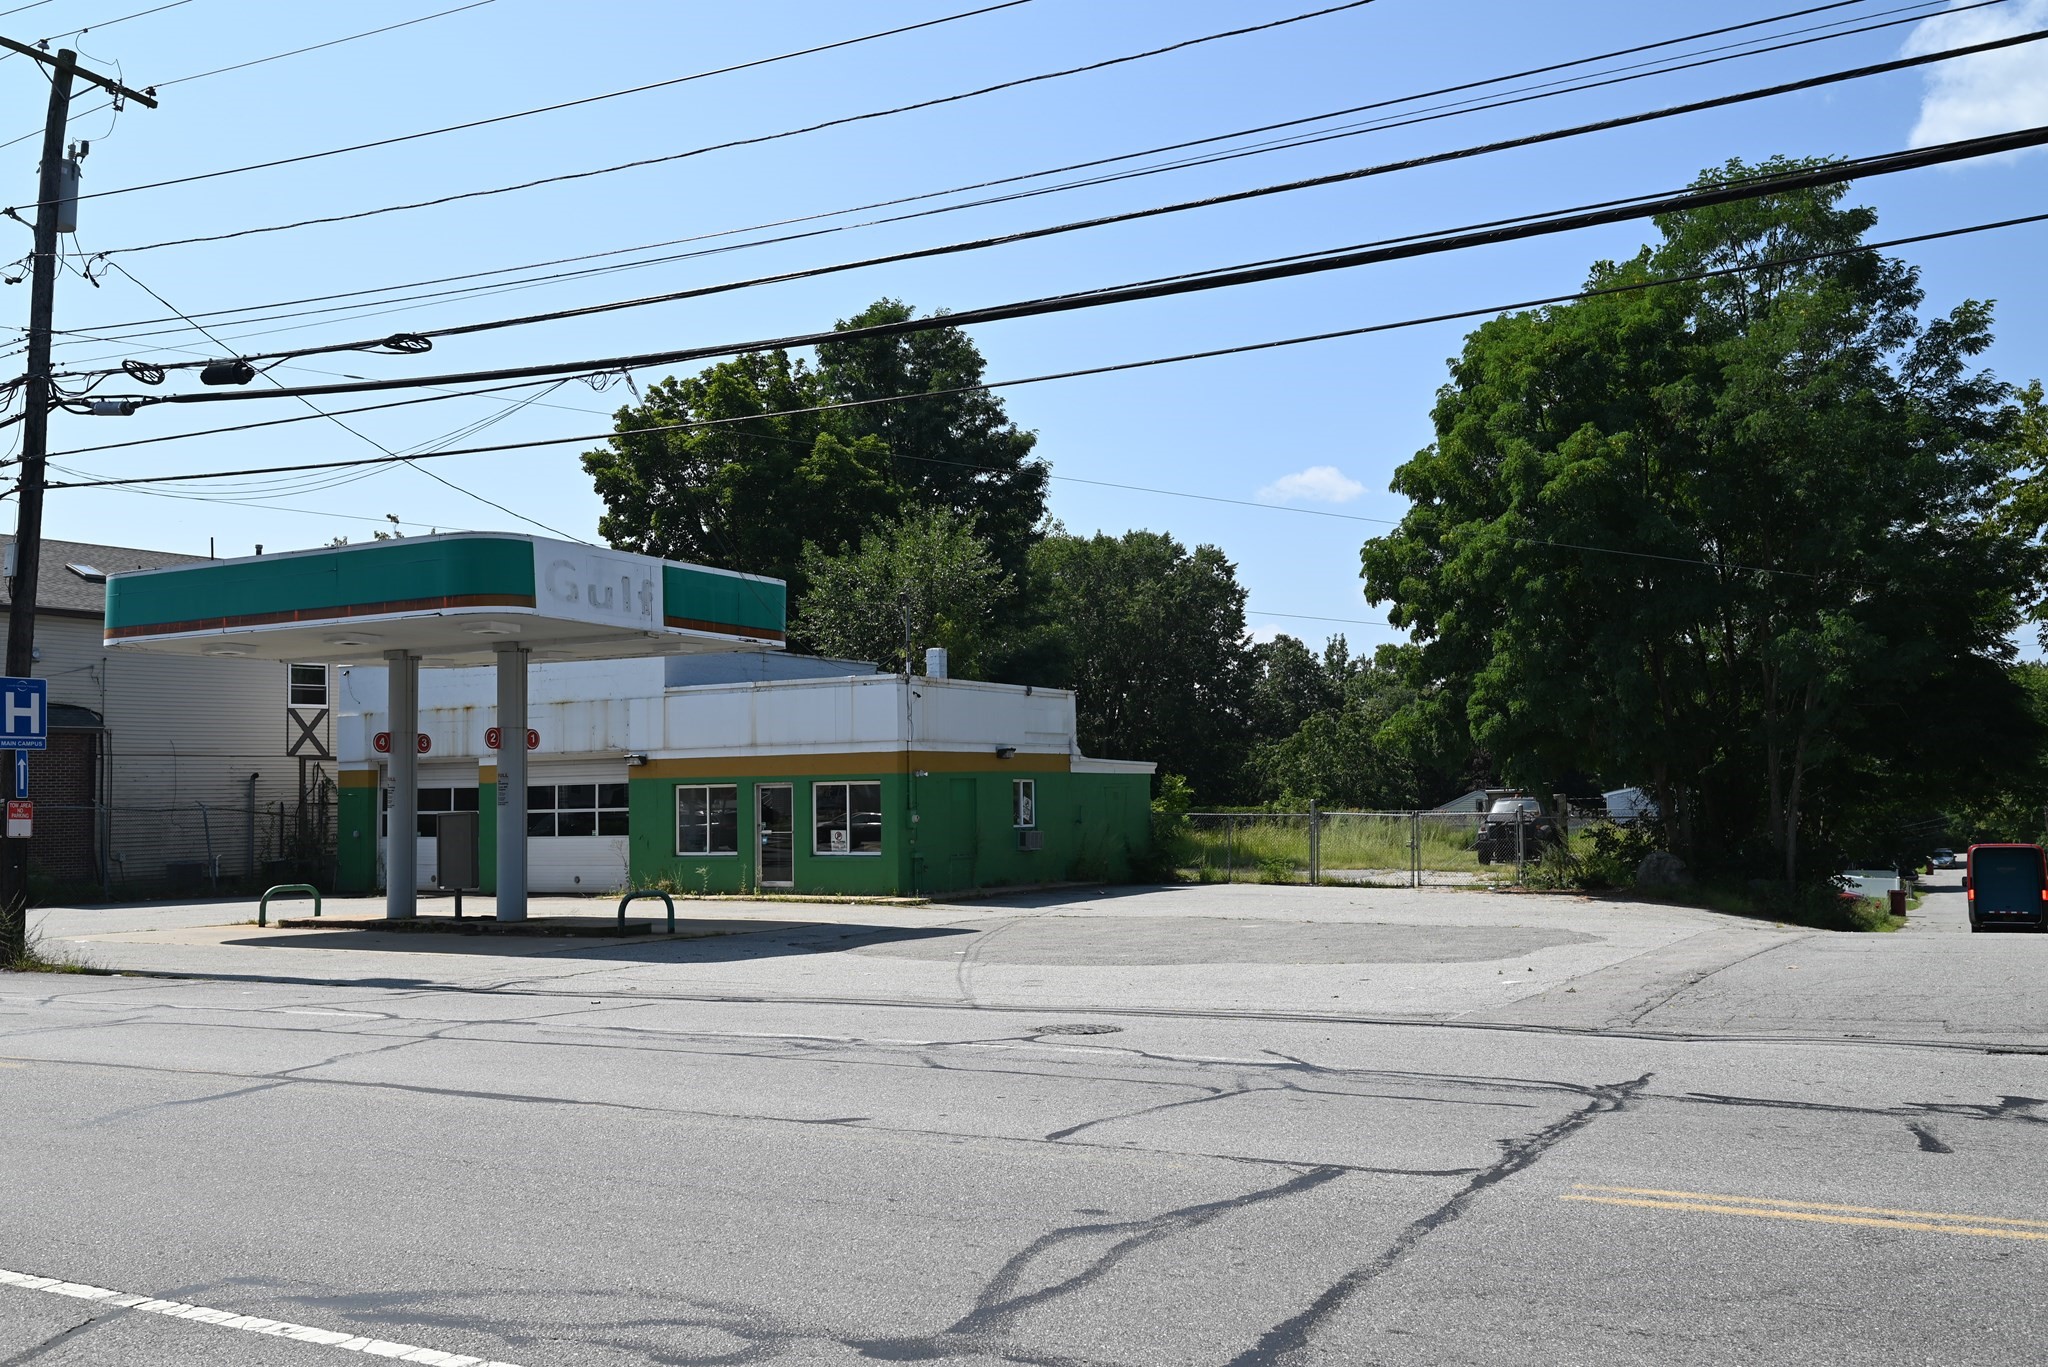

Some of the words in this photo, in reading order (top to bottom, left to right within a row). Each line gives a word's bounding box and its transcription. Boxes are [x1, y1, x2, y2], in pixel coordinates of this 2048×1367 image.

[545, 559, 654, 615] Gulf
[6, 692, 39, 733] H
[379, 737, 386, 746] 4
[490, 733, 497, 742] 2
[531, 734, 535, 743] 1
[421, 738, 427, 747] 3
